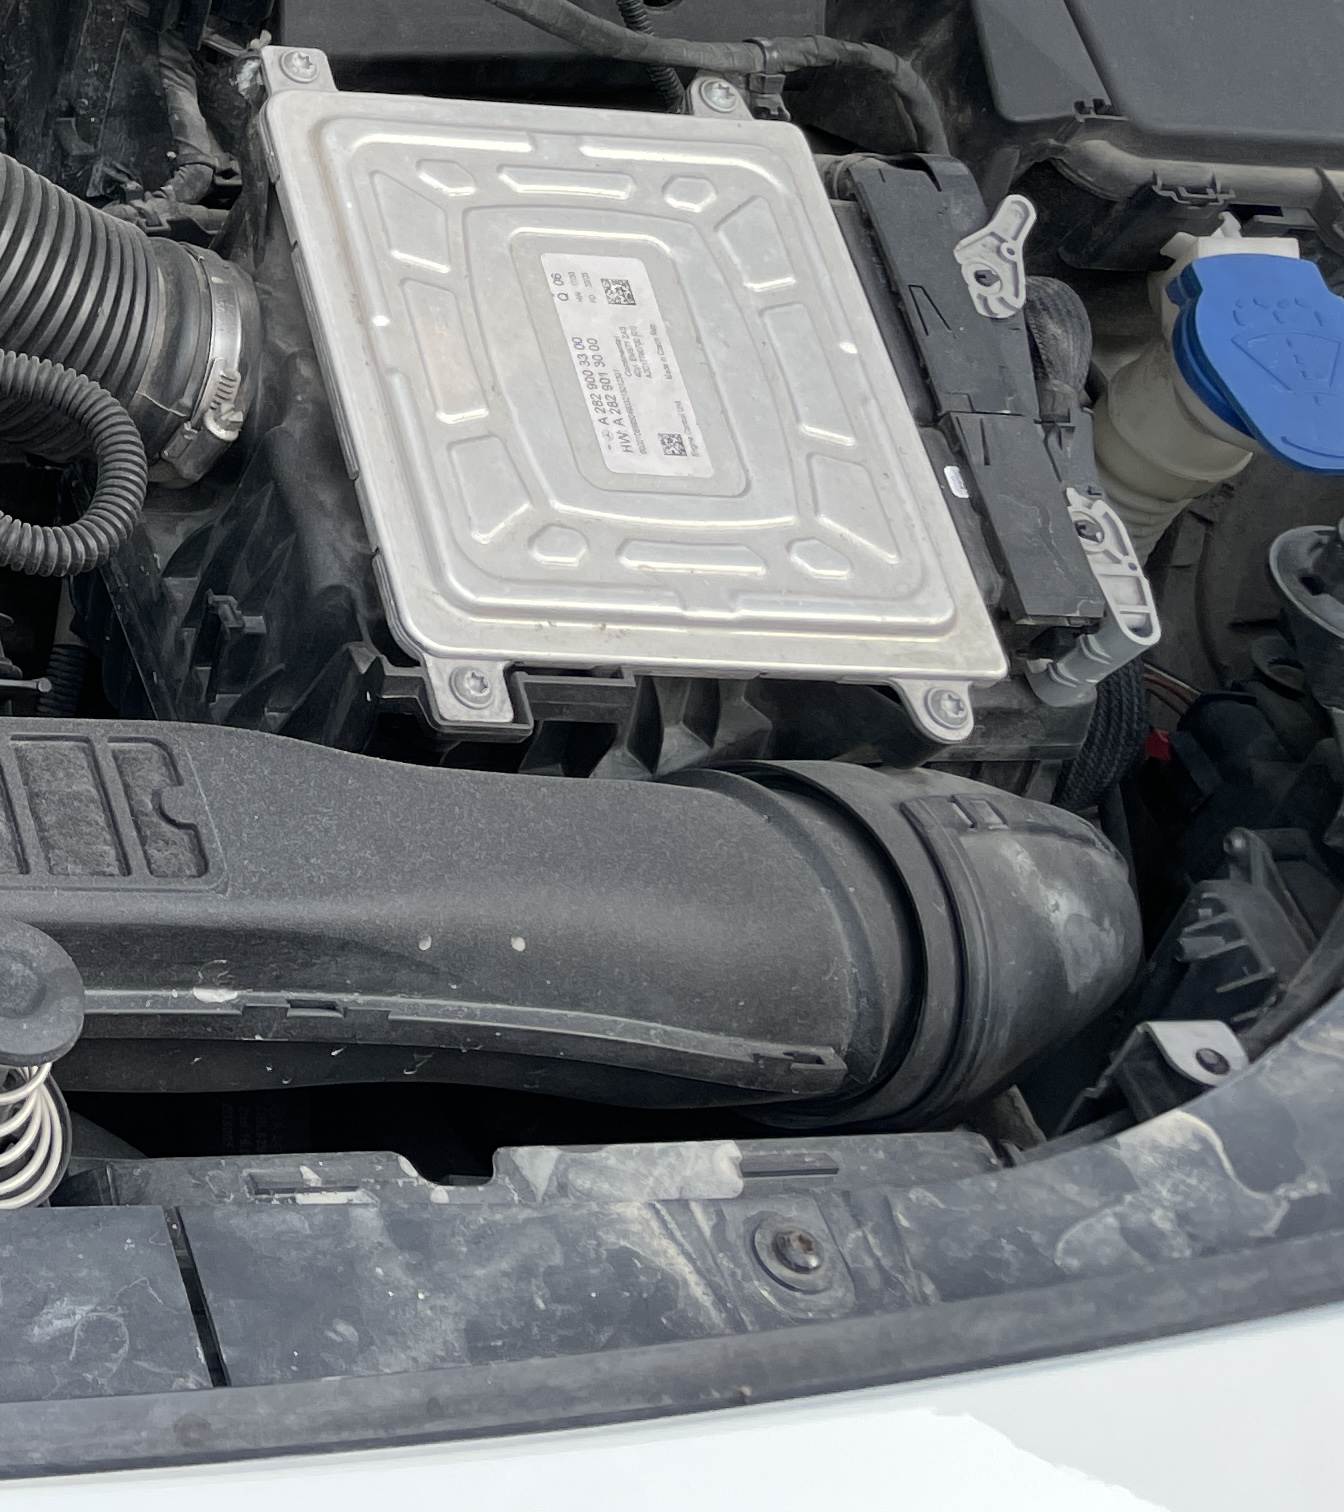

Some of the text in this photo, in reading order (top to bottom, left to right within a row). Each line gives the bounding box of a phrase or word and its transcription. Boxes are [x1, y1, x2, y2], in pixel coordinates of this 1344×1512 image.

[571, 337, 585, 351] 00
[586, 338, 600, 352] 00
[582, 369, 599, 390] 900
[590, 393, 606, 415] 282
[605, 394, 621, 415] 282
[598, 417, 610, 426] A
[613, 417, 626, 428] A
